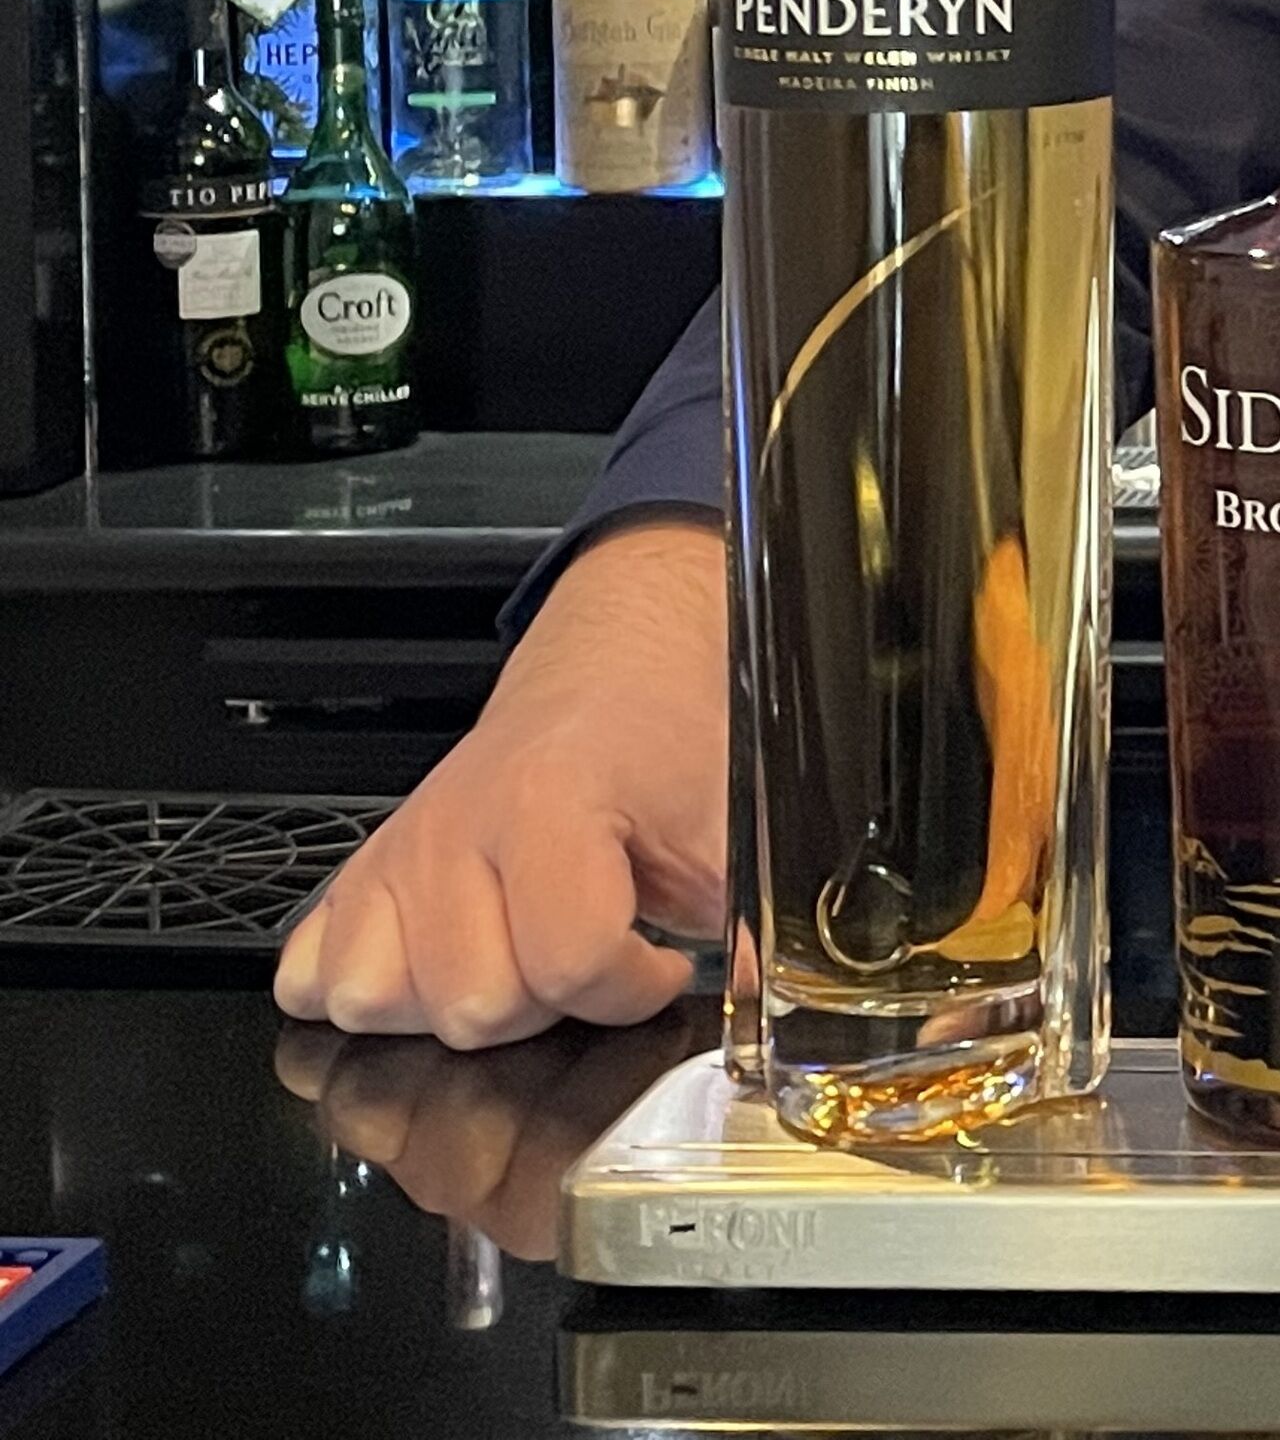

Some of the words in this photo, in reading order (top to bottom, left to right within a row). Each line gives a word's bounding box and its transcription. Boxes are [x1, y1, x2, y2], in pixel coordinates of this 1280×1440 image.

[266, 43, 318, 66] HEP
[785, 47, 833, 65] MALT
[925, 48, 1012, 64] WHISKY
[168, 187, 217, 207] TIO
[317, 287, 397, 324] Croft
